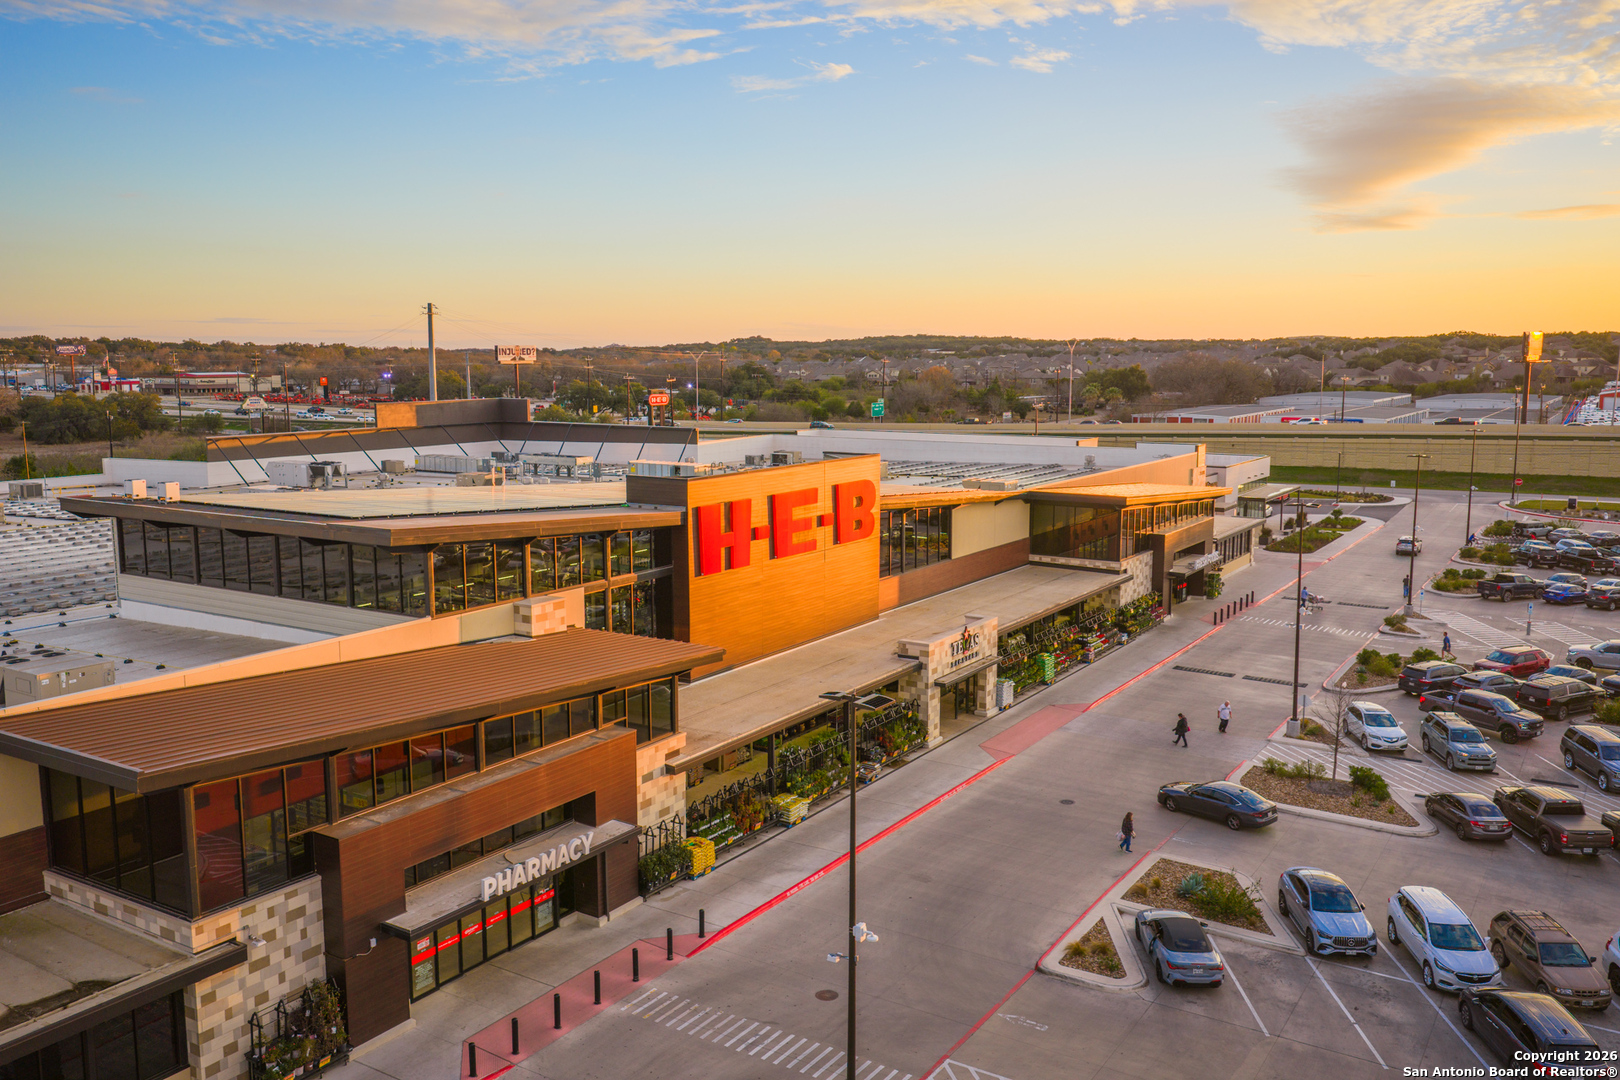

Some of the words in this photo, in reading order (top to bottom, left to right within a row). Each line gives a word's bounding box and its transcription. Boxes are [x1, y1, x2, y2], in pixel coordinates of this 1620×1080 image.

[499, 348, 535, 356] INJUED?
[694, 479, 876, 577] H-E-B
[951, 629, 980, 656] TEXAS
[481, 832, 594, 902] PHARMACY
